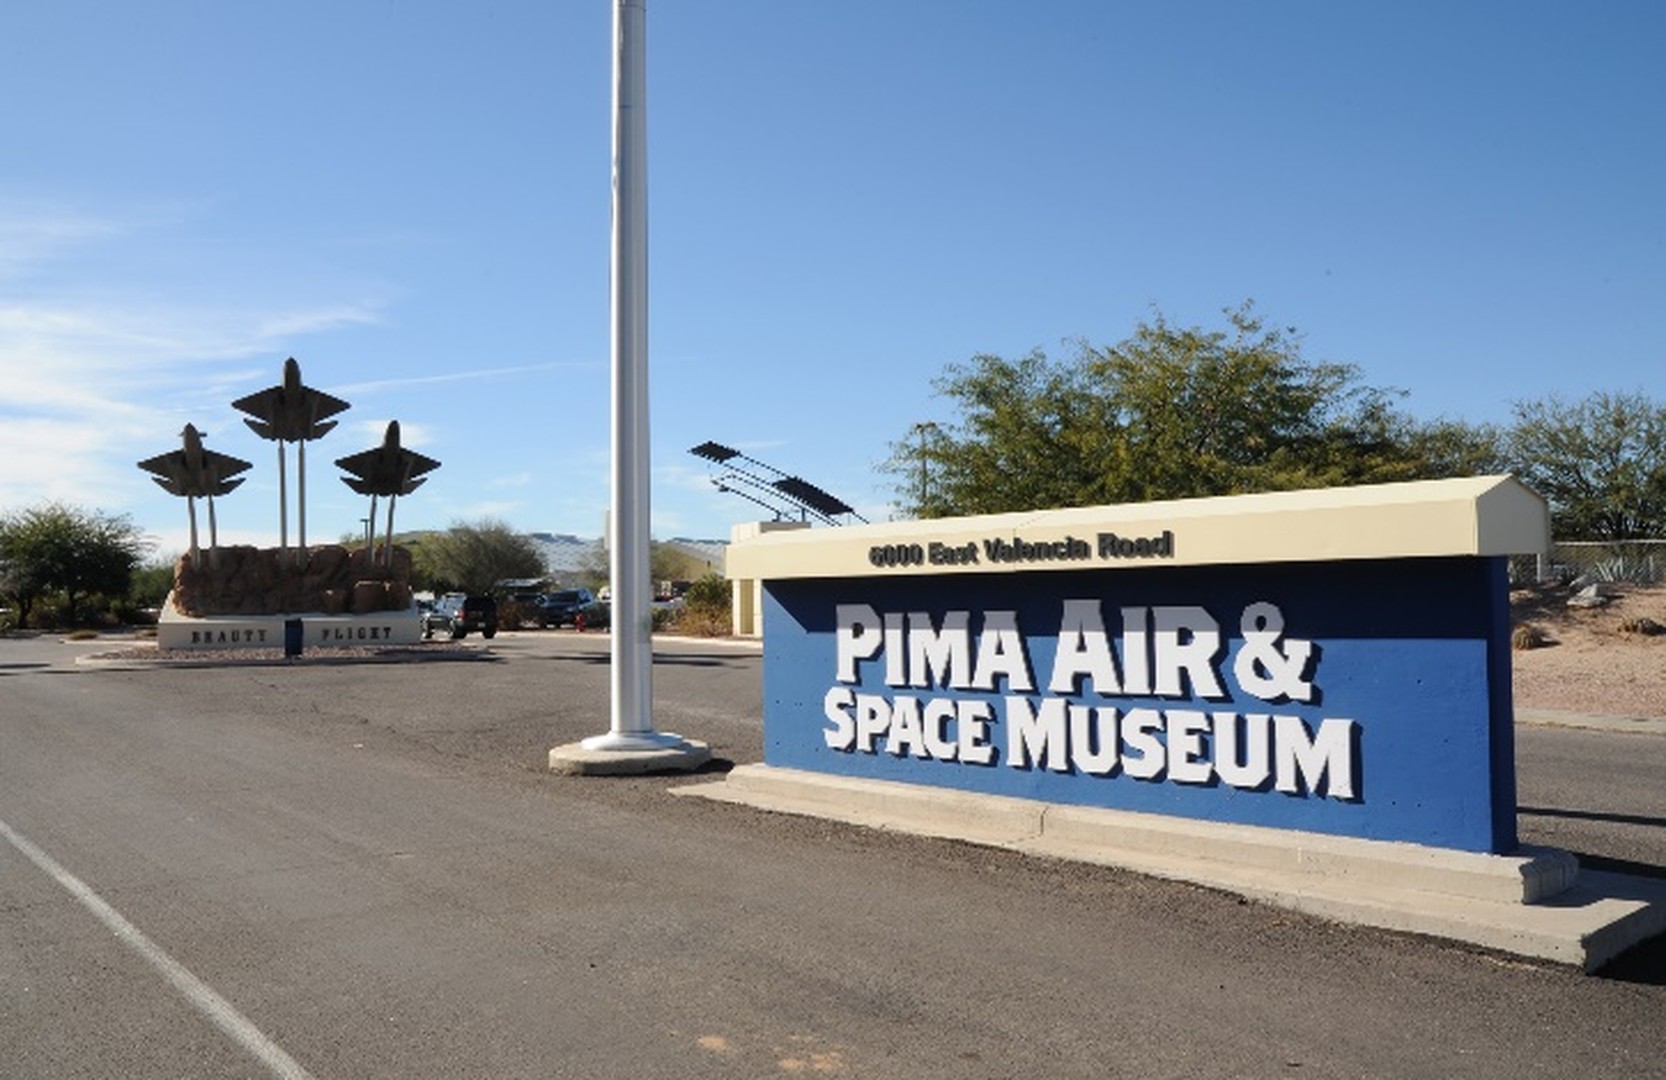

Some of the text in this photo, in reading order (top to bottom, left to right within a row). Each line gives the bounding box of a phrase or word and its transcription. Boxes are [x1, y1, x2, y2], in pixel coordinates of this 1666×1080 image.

[869, 530, 1175, 568] 6000 East Valencia Road
[191, 627, 391, 643] BEAUTY FLIGHT
[834, 599, 1318, 702] PIMA AIR &
[823, 686, 1356, 801] SPACE MUSEUM
